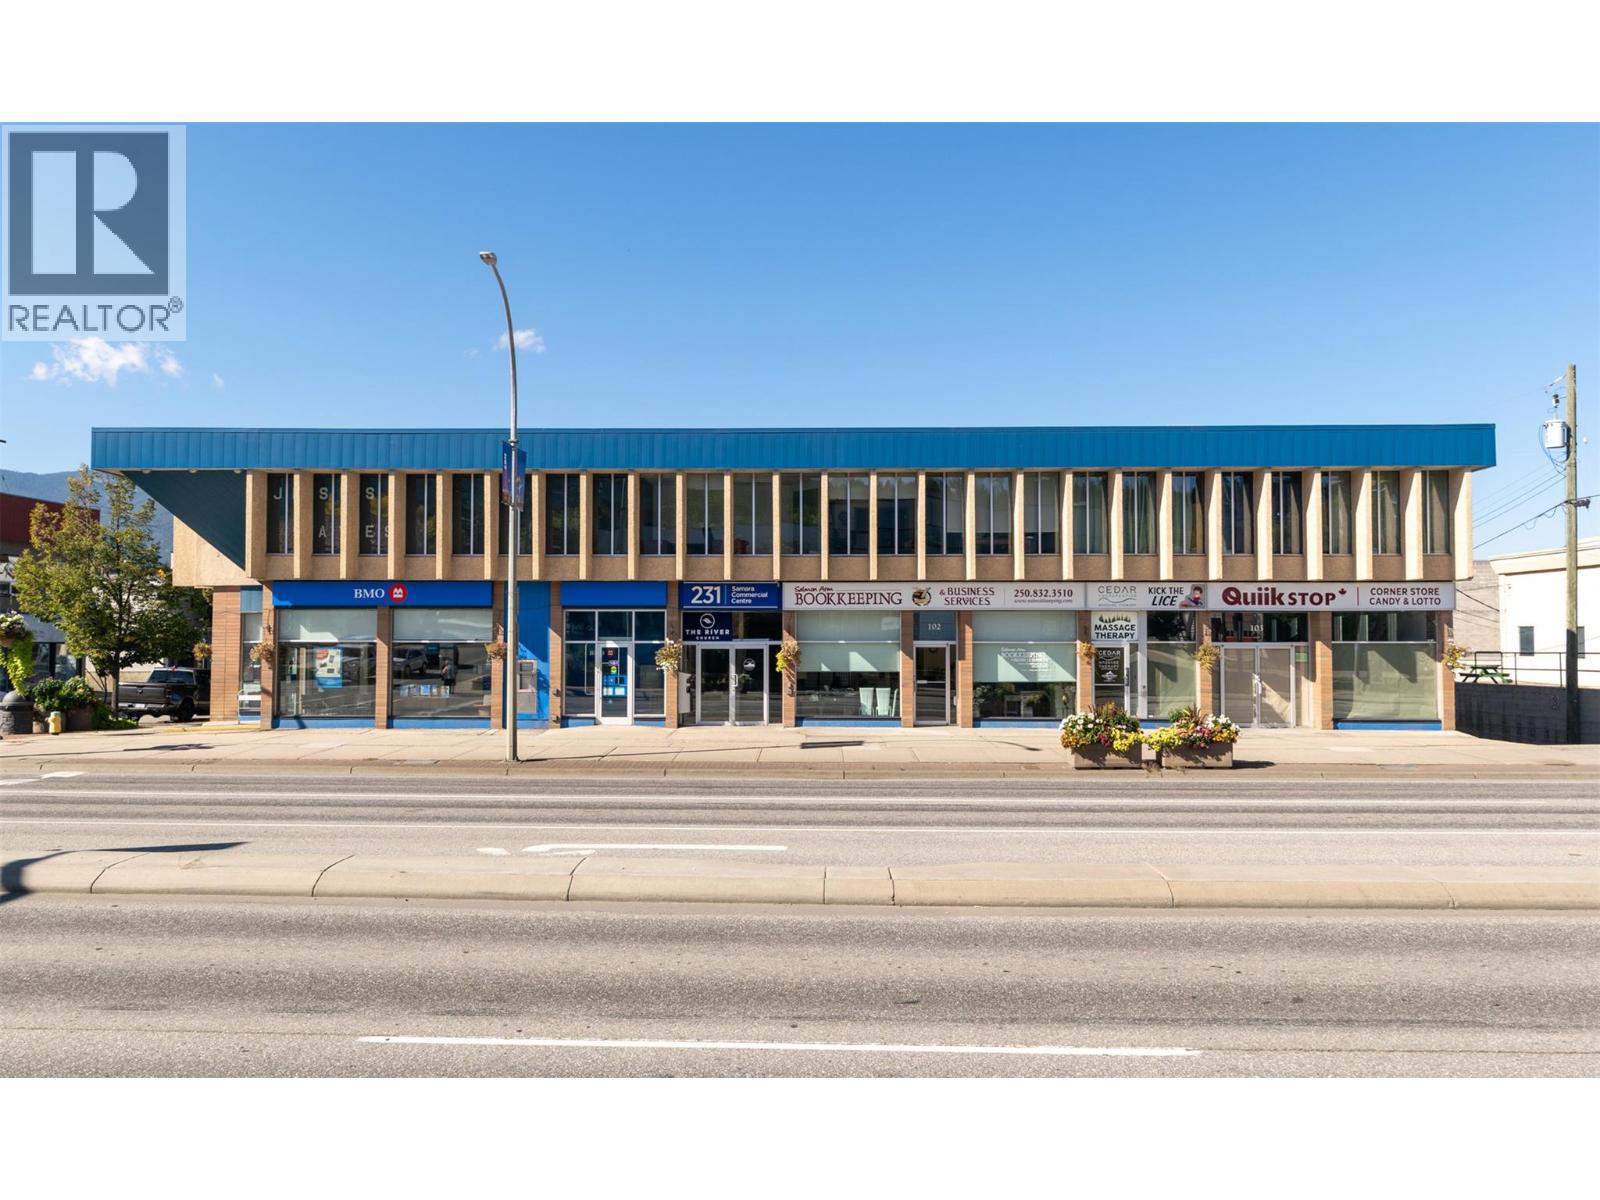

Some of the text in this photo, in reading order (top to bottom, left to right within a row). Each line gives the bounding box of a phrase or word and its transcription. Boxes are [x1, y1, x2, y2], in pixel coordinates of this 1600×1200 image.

[353, 588, 385, 599] BMO
[947, 587, 995, 596] BUSINESS
[1014, 589, 1073, 598] 250.832.3510
[1097, 585, 1137, 594] CEDAR
[1148, 587, 1184, 595] KICK THE
[1370, 587, 1440, 596] CORNER STORE
[691, 585, 720, 604] 231
[795, 592, 902, 606] BOOKKEEPING
[1222, 586, 1336, 606] Quiik STOP
[944, 597, 991, 606] SERVICES
[1151, 596, 1178, 606] LICE
[1369, 597, 1441, 606] CANDY & LOTTO
[1095, 632, 1135, 640] THERAPY
